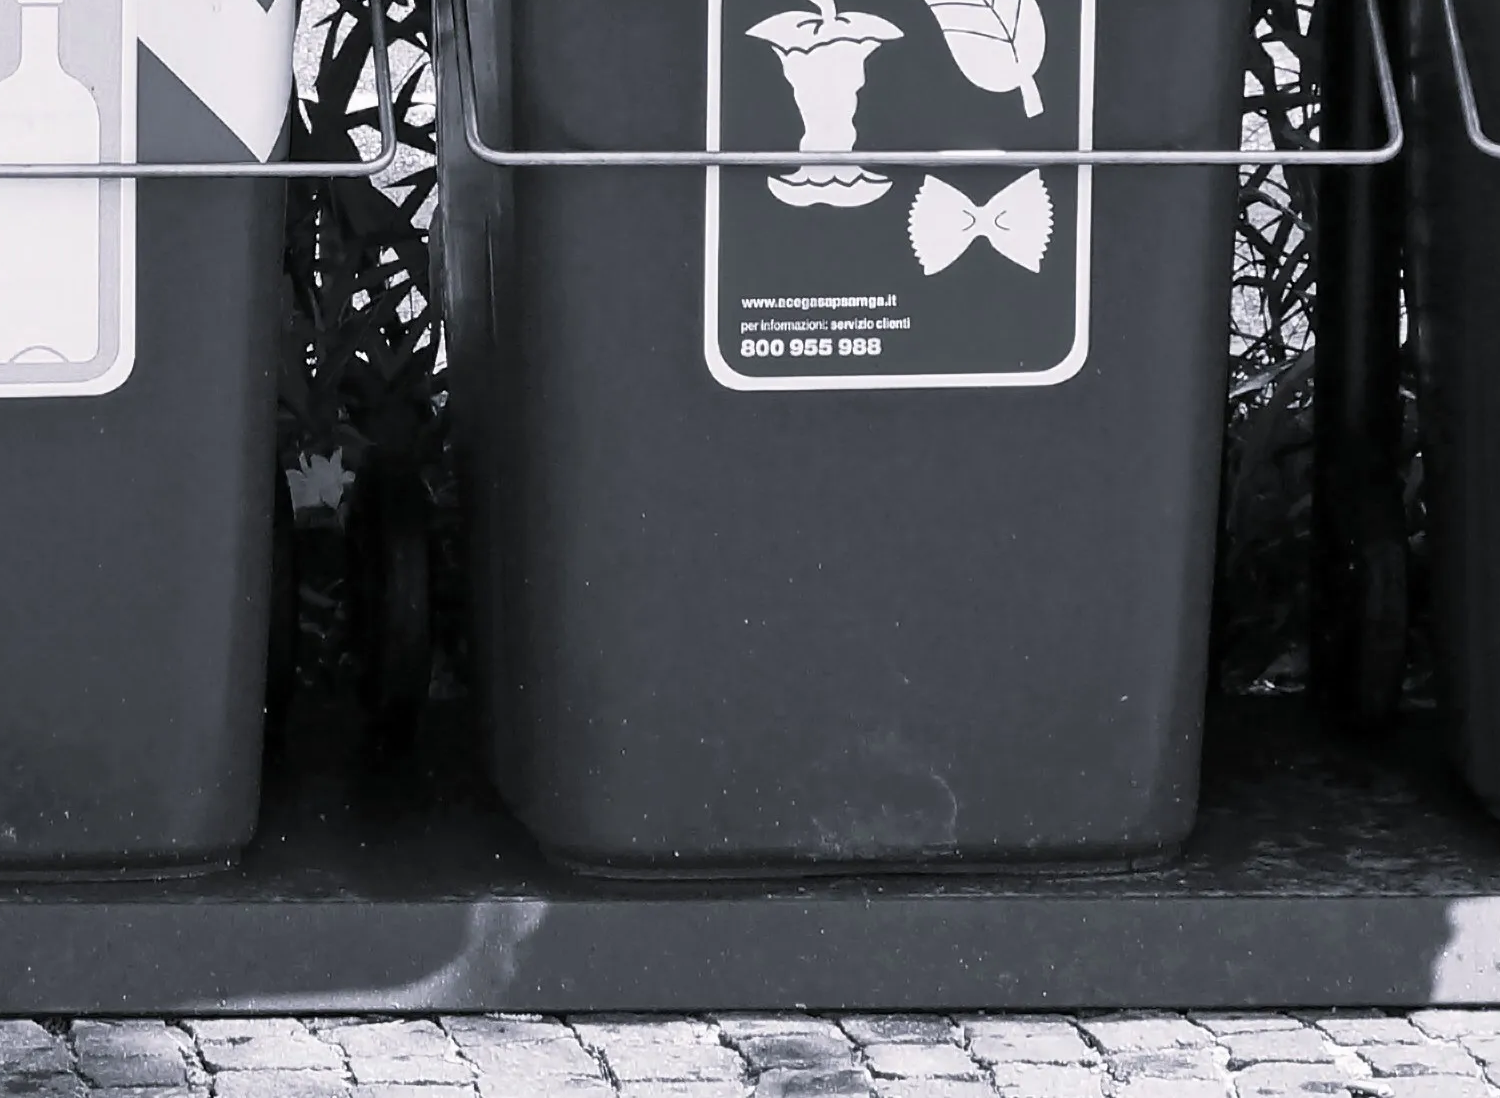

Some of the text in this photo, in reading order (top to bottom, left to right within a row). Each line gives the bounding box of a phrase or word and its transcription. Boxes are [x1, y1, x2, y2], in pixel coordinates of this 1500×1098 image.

[740, 321, 759, 334] per
[830, 318, 874, 330] servizio
[876, 317, 910, 329] clienti
[740, 337, 882, 357] 800 955 988
